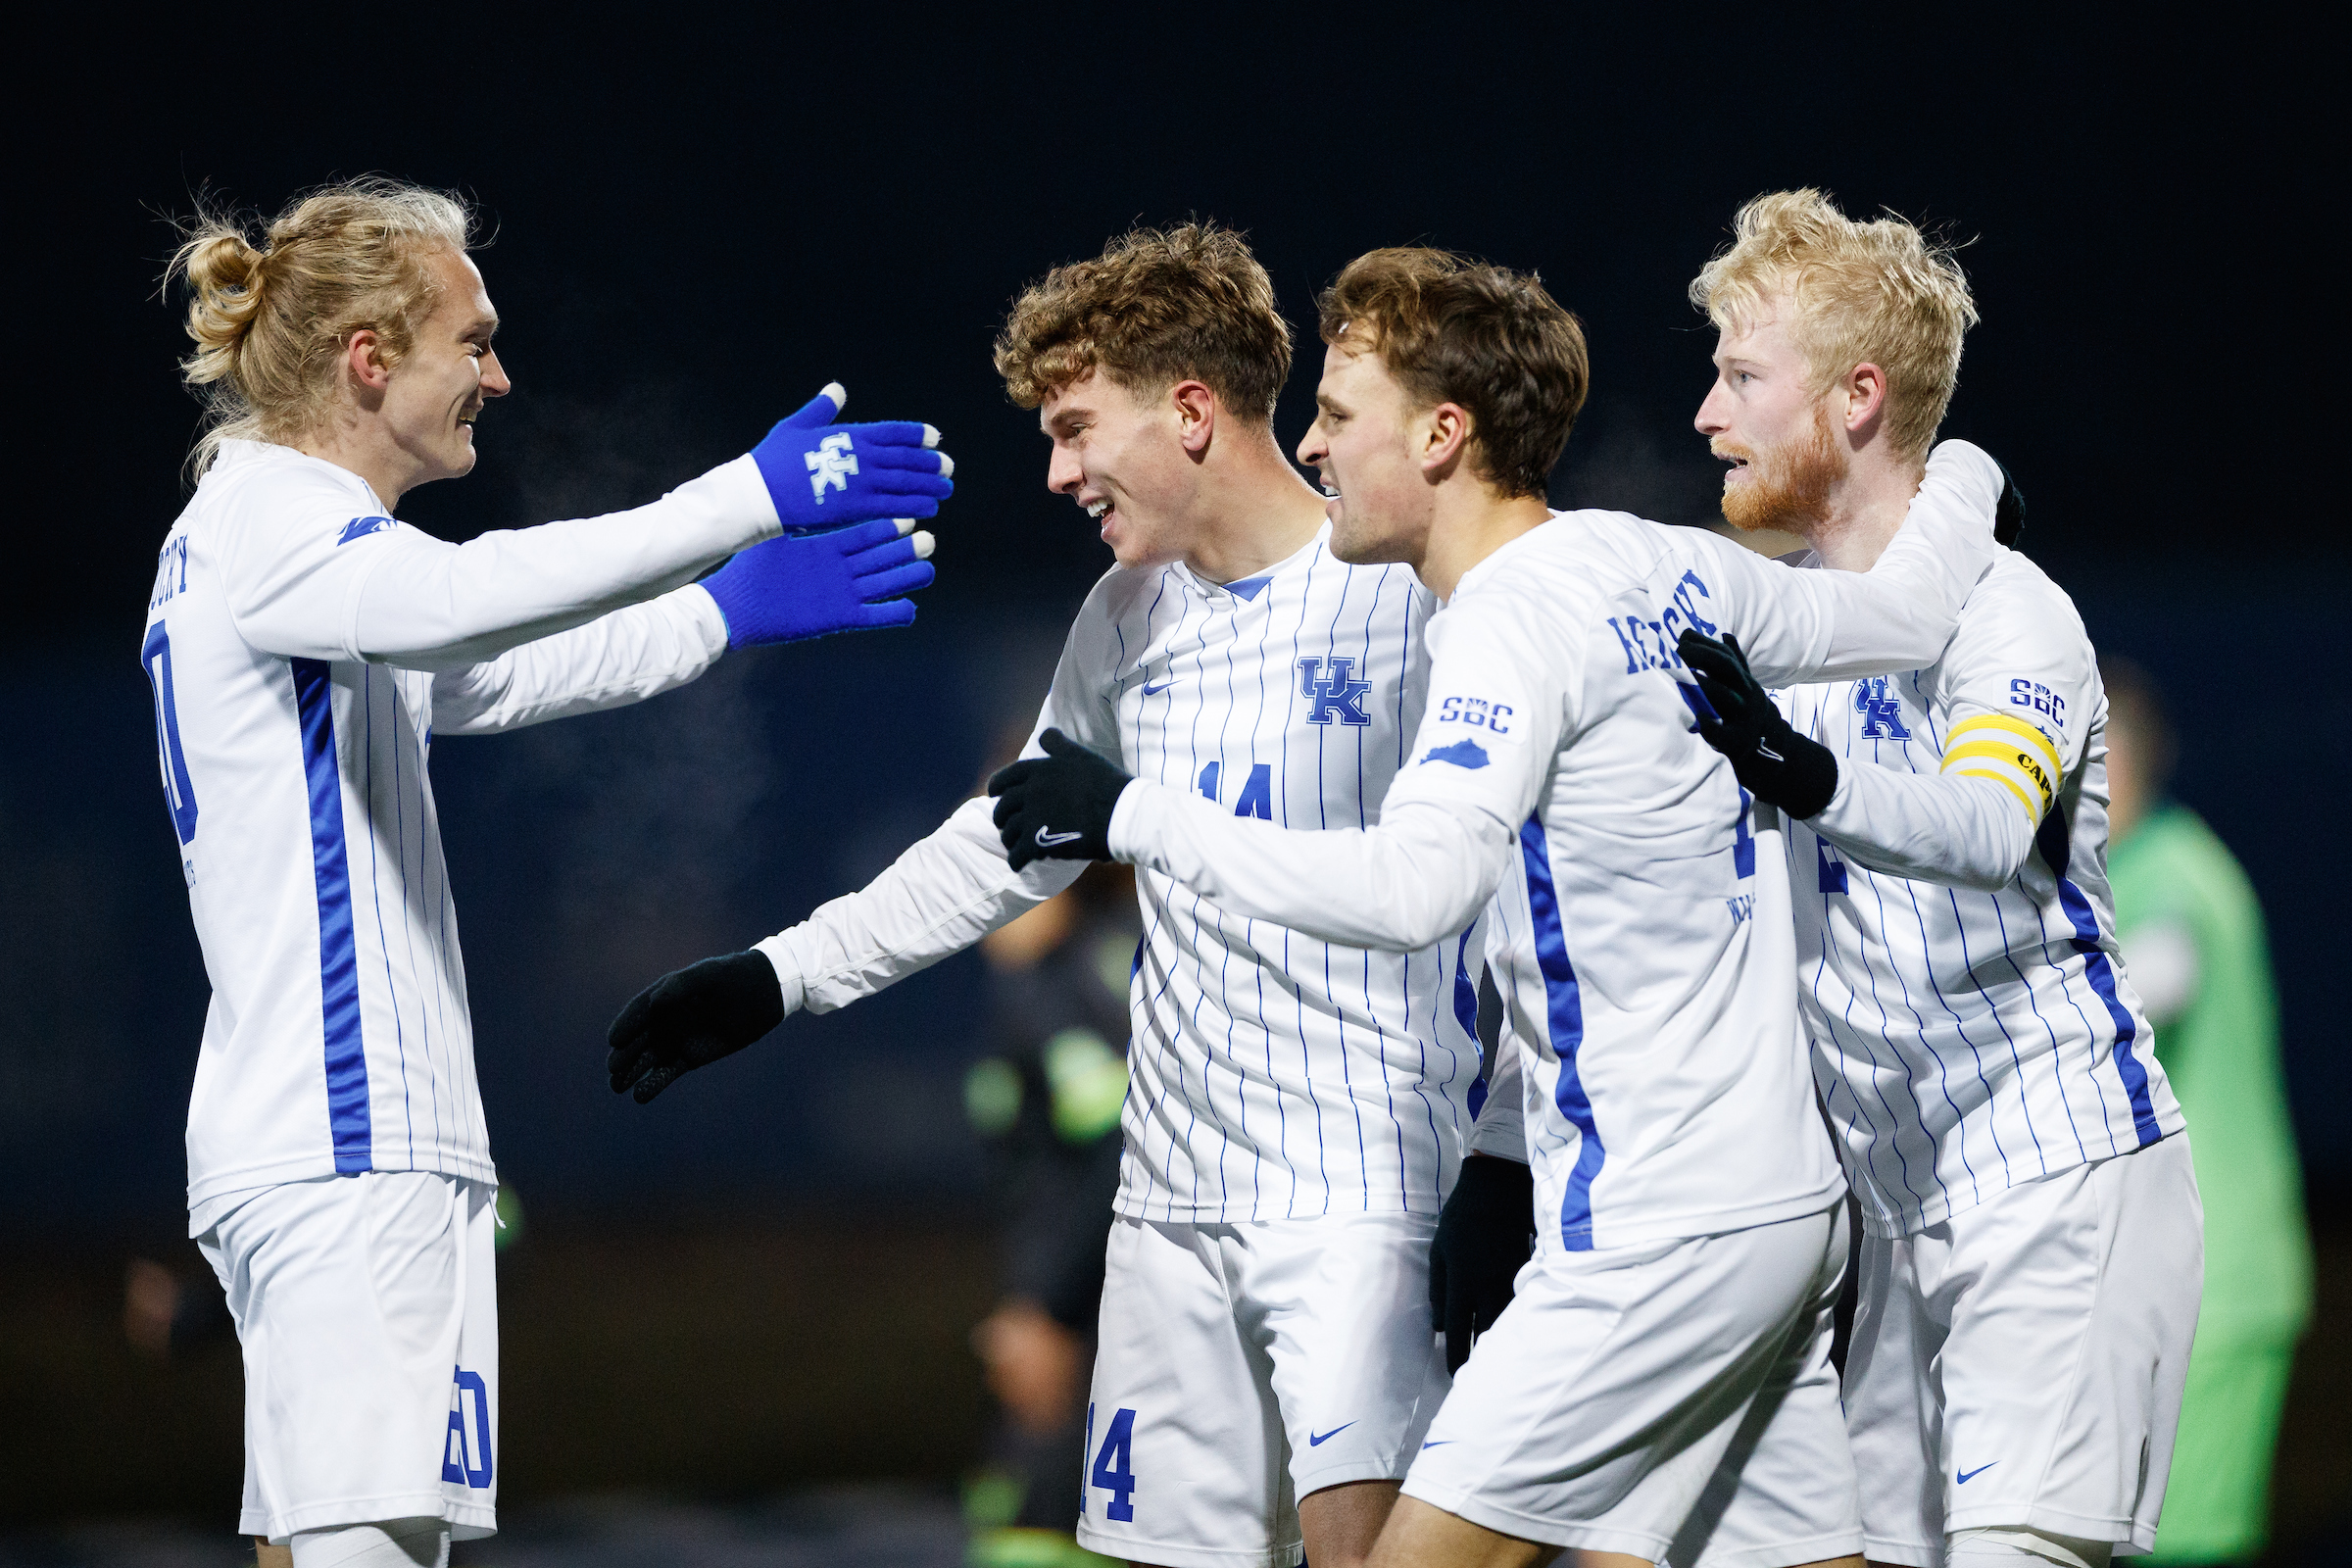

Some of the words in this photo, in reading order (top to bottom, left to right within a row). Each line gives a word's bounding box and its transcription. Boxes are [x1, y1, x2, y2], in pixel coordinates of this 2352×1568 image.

[1298, 656, 1372, 726] UK
[1440, 697, 1513, 734] SBC
[2010, 678, 2065, 728] SBC
